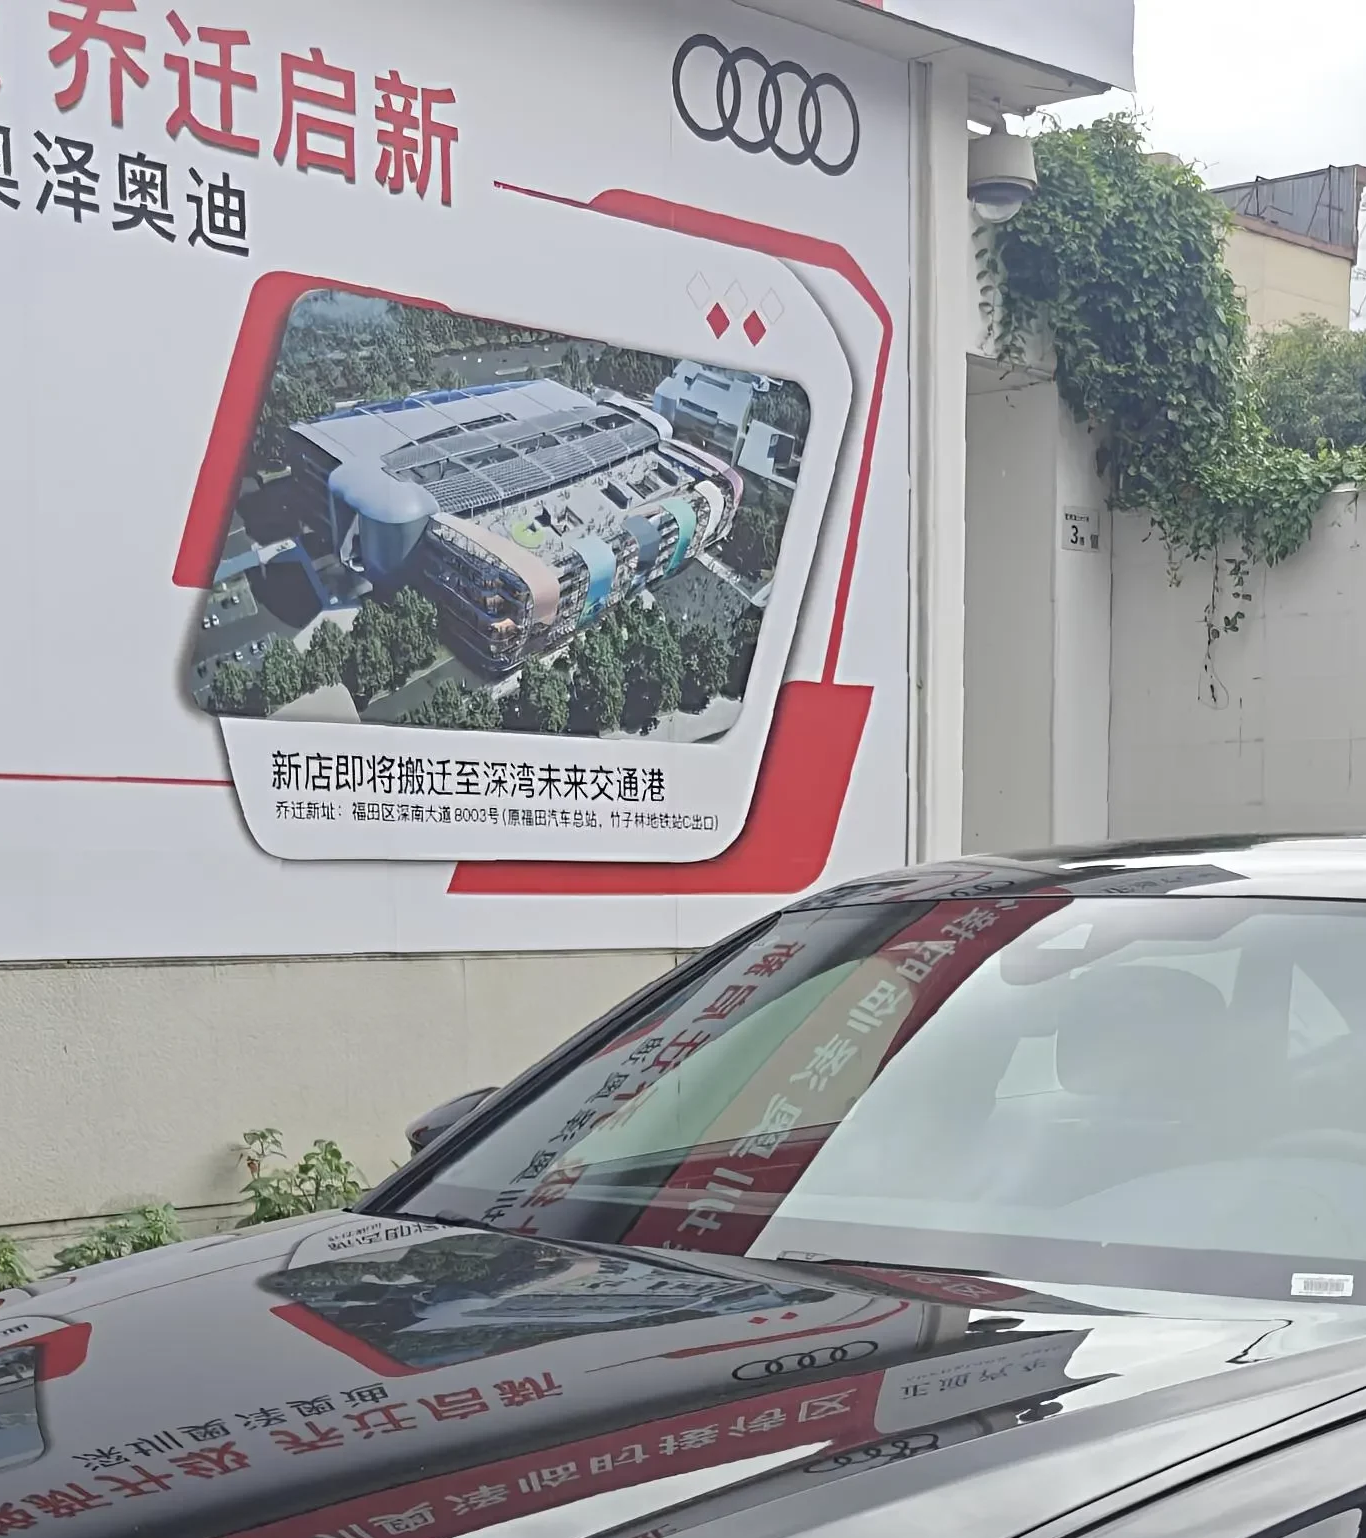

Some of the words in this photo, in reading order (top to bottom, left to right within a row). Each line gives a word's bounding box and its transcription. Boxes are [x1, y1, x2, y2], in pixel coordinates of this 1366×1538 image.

[48, 0, 459, 207] 乔迁启新
[272, 750, 666, 802] 新店即将搬迁至深湾未来交通港
